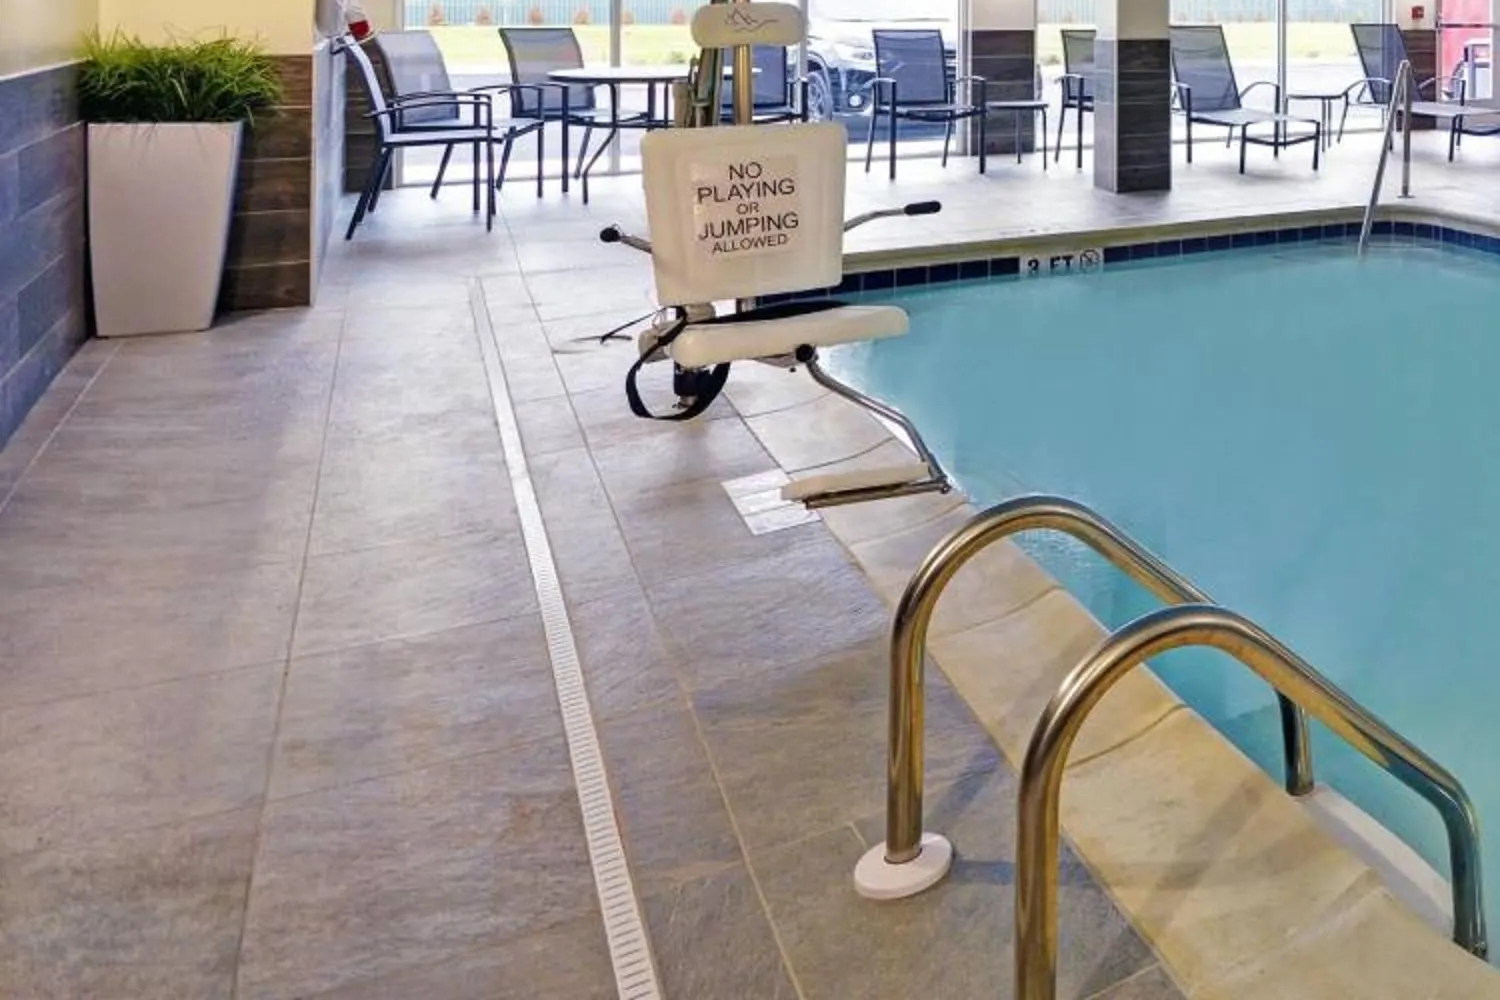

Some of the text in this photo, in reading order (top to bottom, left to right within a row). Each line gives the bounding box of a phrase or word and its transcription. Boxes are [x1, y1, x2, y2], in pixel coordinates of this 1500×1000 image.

[729, 162, 762, 181] NO
[697, 178, 795, 204] PLAYING
[736, 202, 760, 215] OR
[699, 212, 799, 241] JUMPING
[712, 234, 788, 254] ALLOWED
